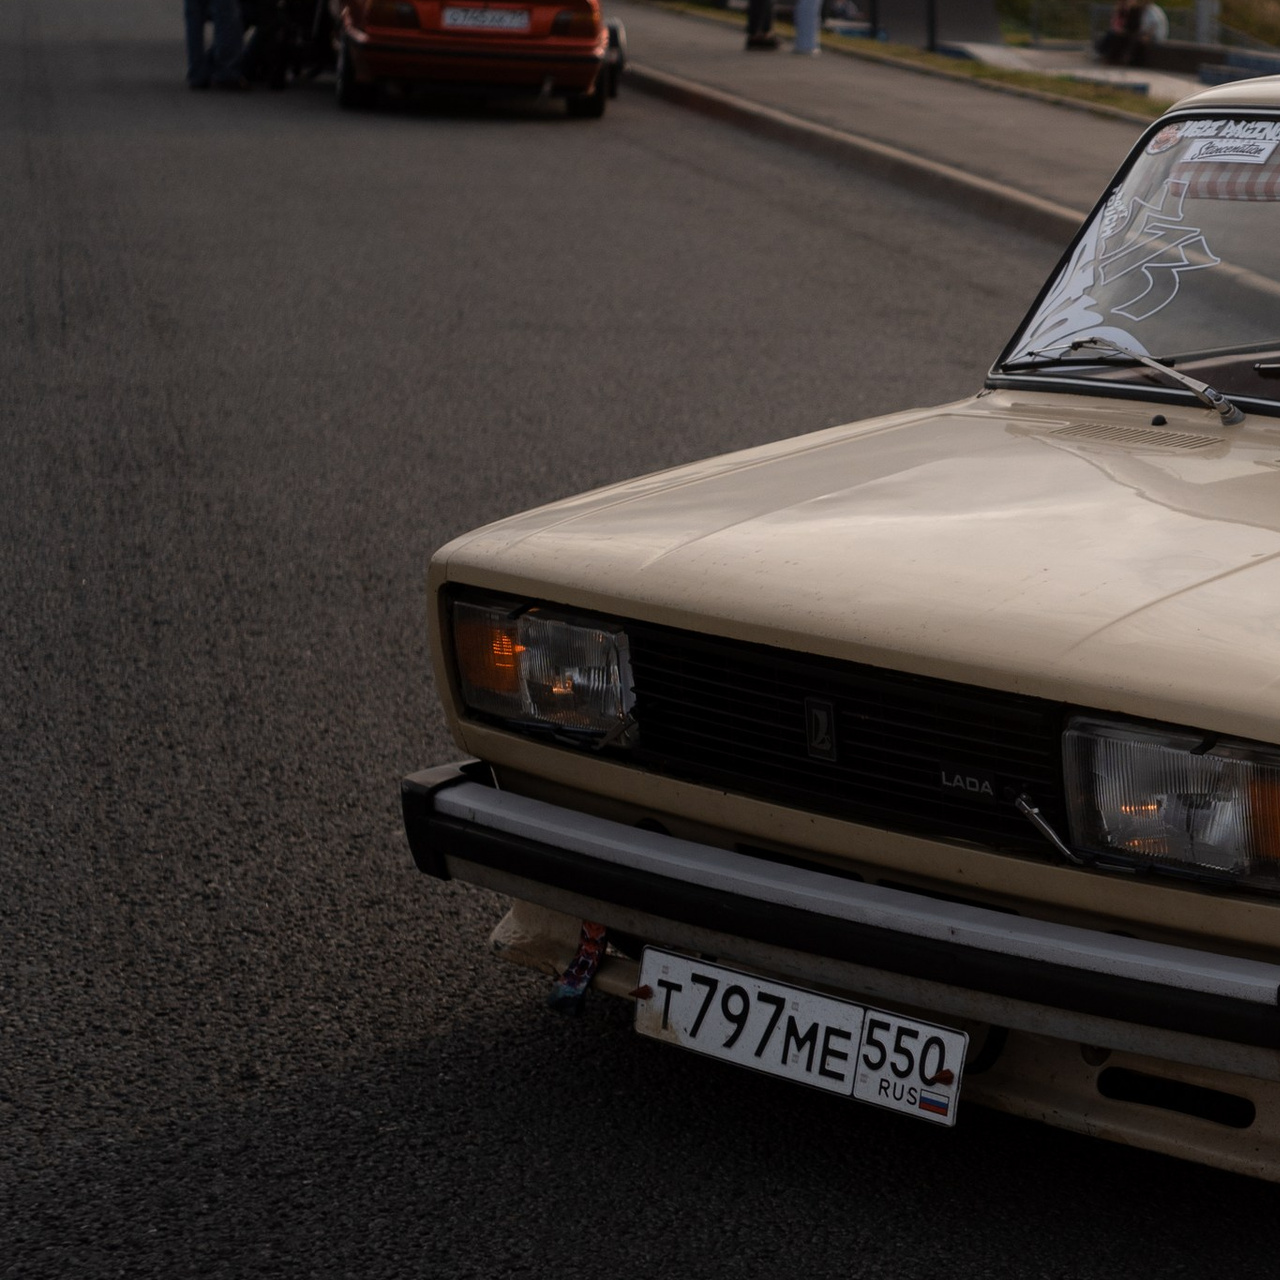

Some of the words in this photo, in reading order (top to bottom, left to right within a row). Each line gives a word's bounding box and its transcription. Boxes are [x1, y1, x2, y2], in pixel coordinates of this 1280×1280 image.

[1191, 141, 1264, 160] Stancenation
[1100, 184, 1123, 238] TOUCH
[941, 770, 994, 796] LADA
[656, 972, 853, 1082] Т797МЕ
[862, 1017, 947, 1087] 550
[877, 1078, 919, 1106] RUS
